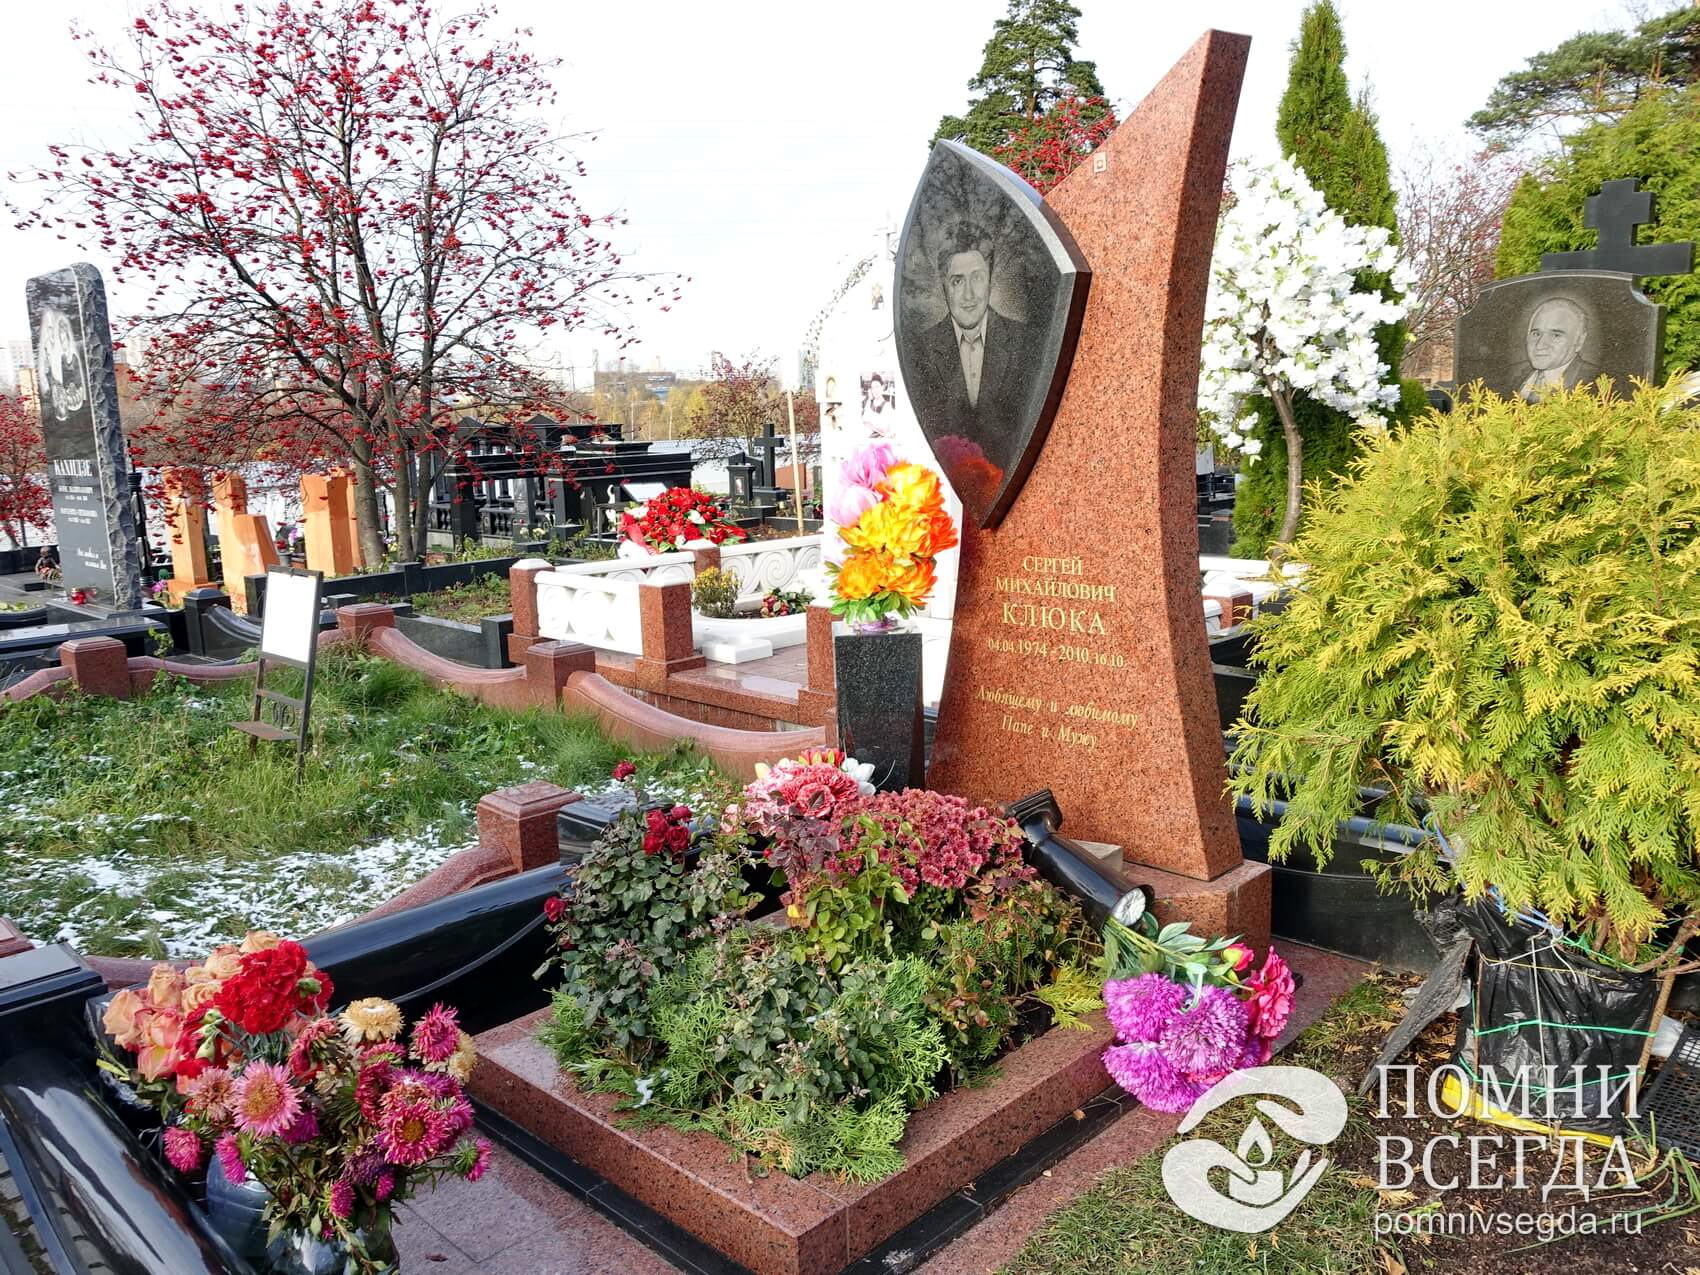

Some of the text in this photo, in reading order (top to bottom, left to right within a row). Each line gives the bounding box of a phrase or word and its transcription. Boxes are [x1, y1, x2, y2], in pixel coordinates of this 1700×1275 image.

[1023, 555, 1083, 576] СЕРГЕЙ
[994, 577, 1117, 603] МИХАЙЛОВИЧ
[1002, 603, 1106, 636] КЛЮКА
[988, 639, 1048, 658] 04.04.1974
[1058, 645, 1124, 668] 2010.16.10
[975, 685, 1138, 730] Любящему и любимому
[1000, 714, 1097, 749] Папе и Мужу
